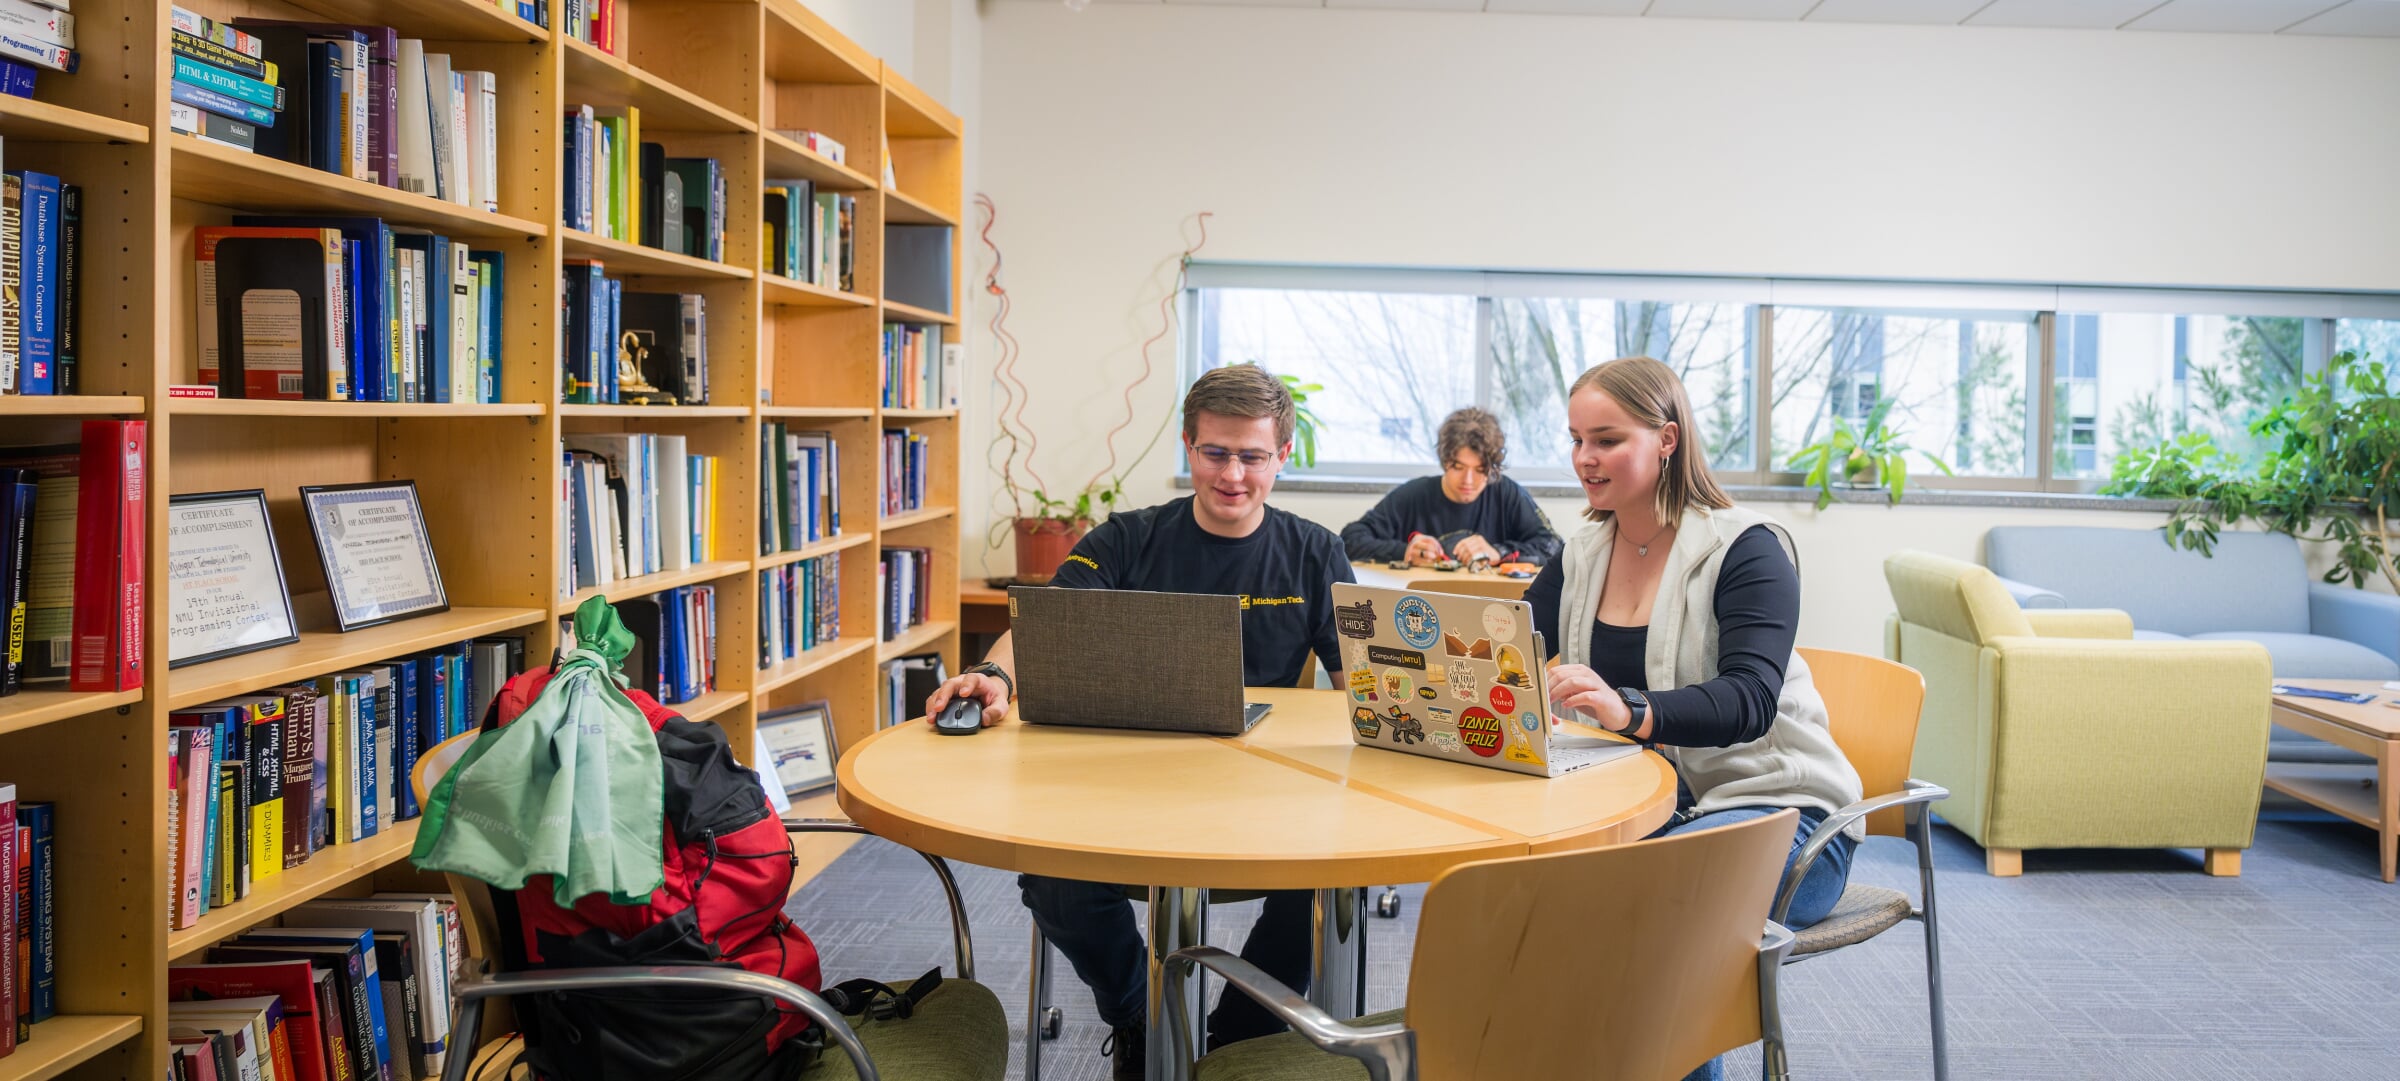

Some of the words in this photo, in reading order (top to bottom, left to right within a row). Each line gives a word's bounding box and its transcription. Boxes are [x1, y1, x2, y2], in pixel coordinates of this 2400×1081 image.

[2, 36, 45, 57] Programming
[58, 50, 69, 64] 24
[198, 38, 206, 48] 3D
[206, 40, 222, 55] Game
[357, 43, 366, 68] Best
[179, 63, 202, 80] HTML
[203, 71, 210, 83] &
[211, 73, 238, 91] XHTML
[356, 71, 366, 97] Jobs
[389, 87, 397, 110] C++
[180, 110, 187, 120] XT
[230, 124, 248, 137] Noldus
[354, 123, 365, 167] Century
[38, 194, 48, 244] Database
[3, 207, 20, 286] COMPUTER
[66, 226, 74, 242] DATA
[37, 245, 47, 282] System
[66, 243, 74, 281] STRUCTURES
[335, 268, 343, 321] STRUCTURED
[403, 280, 411, 306] C++
[35, 284, 46, 332] Concepts
[331, 287, 340, 348] ORGANIZATION
[64, 331, 72, 349] JAVA
[403, 346, 411, 375] Library
[181, 508, 235, 521] CERTIFICATE
[348, 518, 357, 527] OF
[357, 513, 410, 526] ACCOMPLISHMENT
[358, 505, 398, 517] CERTIFICATE
[180, 519, 254, 535] ACCOMPLISHMENT
[126, 583, 134, 606] More
[186, 595, 209, 609] 19th
[213, 590, 246, 604] Annual
[1252, 597, 1287, 606] Michigan
[170, 619, 232, 638] Programming
[235, 611, 272, 626] Contest
[175, 611, 194, 624] NMU
[198, 600, 261, 620] Invitational
[12, 615, 23, 648] USED
[126, 607, 134, 662] Convenient!
[133, 605, 141, 660] Expensive!
[1491, 697, 1513, 707] Voted
[286, 695, 304, 759] Truman
[299, 696, 316, 739] Harry
[365, 718, 374, 743] JAVA,
[1457, 716, 1500, 732] SANTA
[262, 748, 269, 757] &
[269, 723, 279, 756] HTML,
[301, 742, 314, 756] S.
[1463, 732, 1498, 748] CRUZ
[262, 758, 270, 777] CSS
[366, 743, 375, 766] JAVA,
[195, 753, 205, 790] Computer
[212, 763, 220, 785] Using
[269, 758, 279, 797] XHTML,
[283, 762, 314, 775] Margaret
[284, 774, 312, 785] Truman
[367, 766, 376, 787] JAVA
[193, 792, 203, 820] Science
[211, 787, 219, 802] MPI
[191, 821, 202, 868] Illuminated
[263, 811, 273, 862] DUMMIES
[3, 841, 11, 883] MODERN
[44, 845, 52, 914] OPERATING
[3, 886, 12, 931] DATABASE
[44, 916, 53, 974] SYSTEMS
[3, 932, 12, 999] MANAGEMENT
[358, 981, 371, 1025] BUSINESS
[274, 1016, 285, 1056] OpenGL
[352, 986, 371, 1071] COMMUNICATIONS
[364, 1028, 375, 1051] DATA
[334, 1036, 349, 1081] Android
